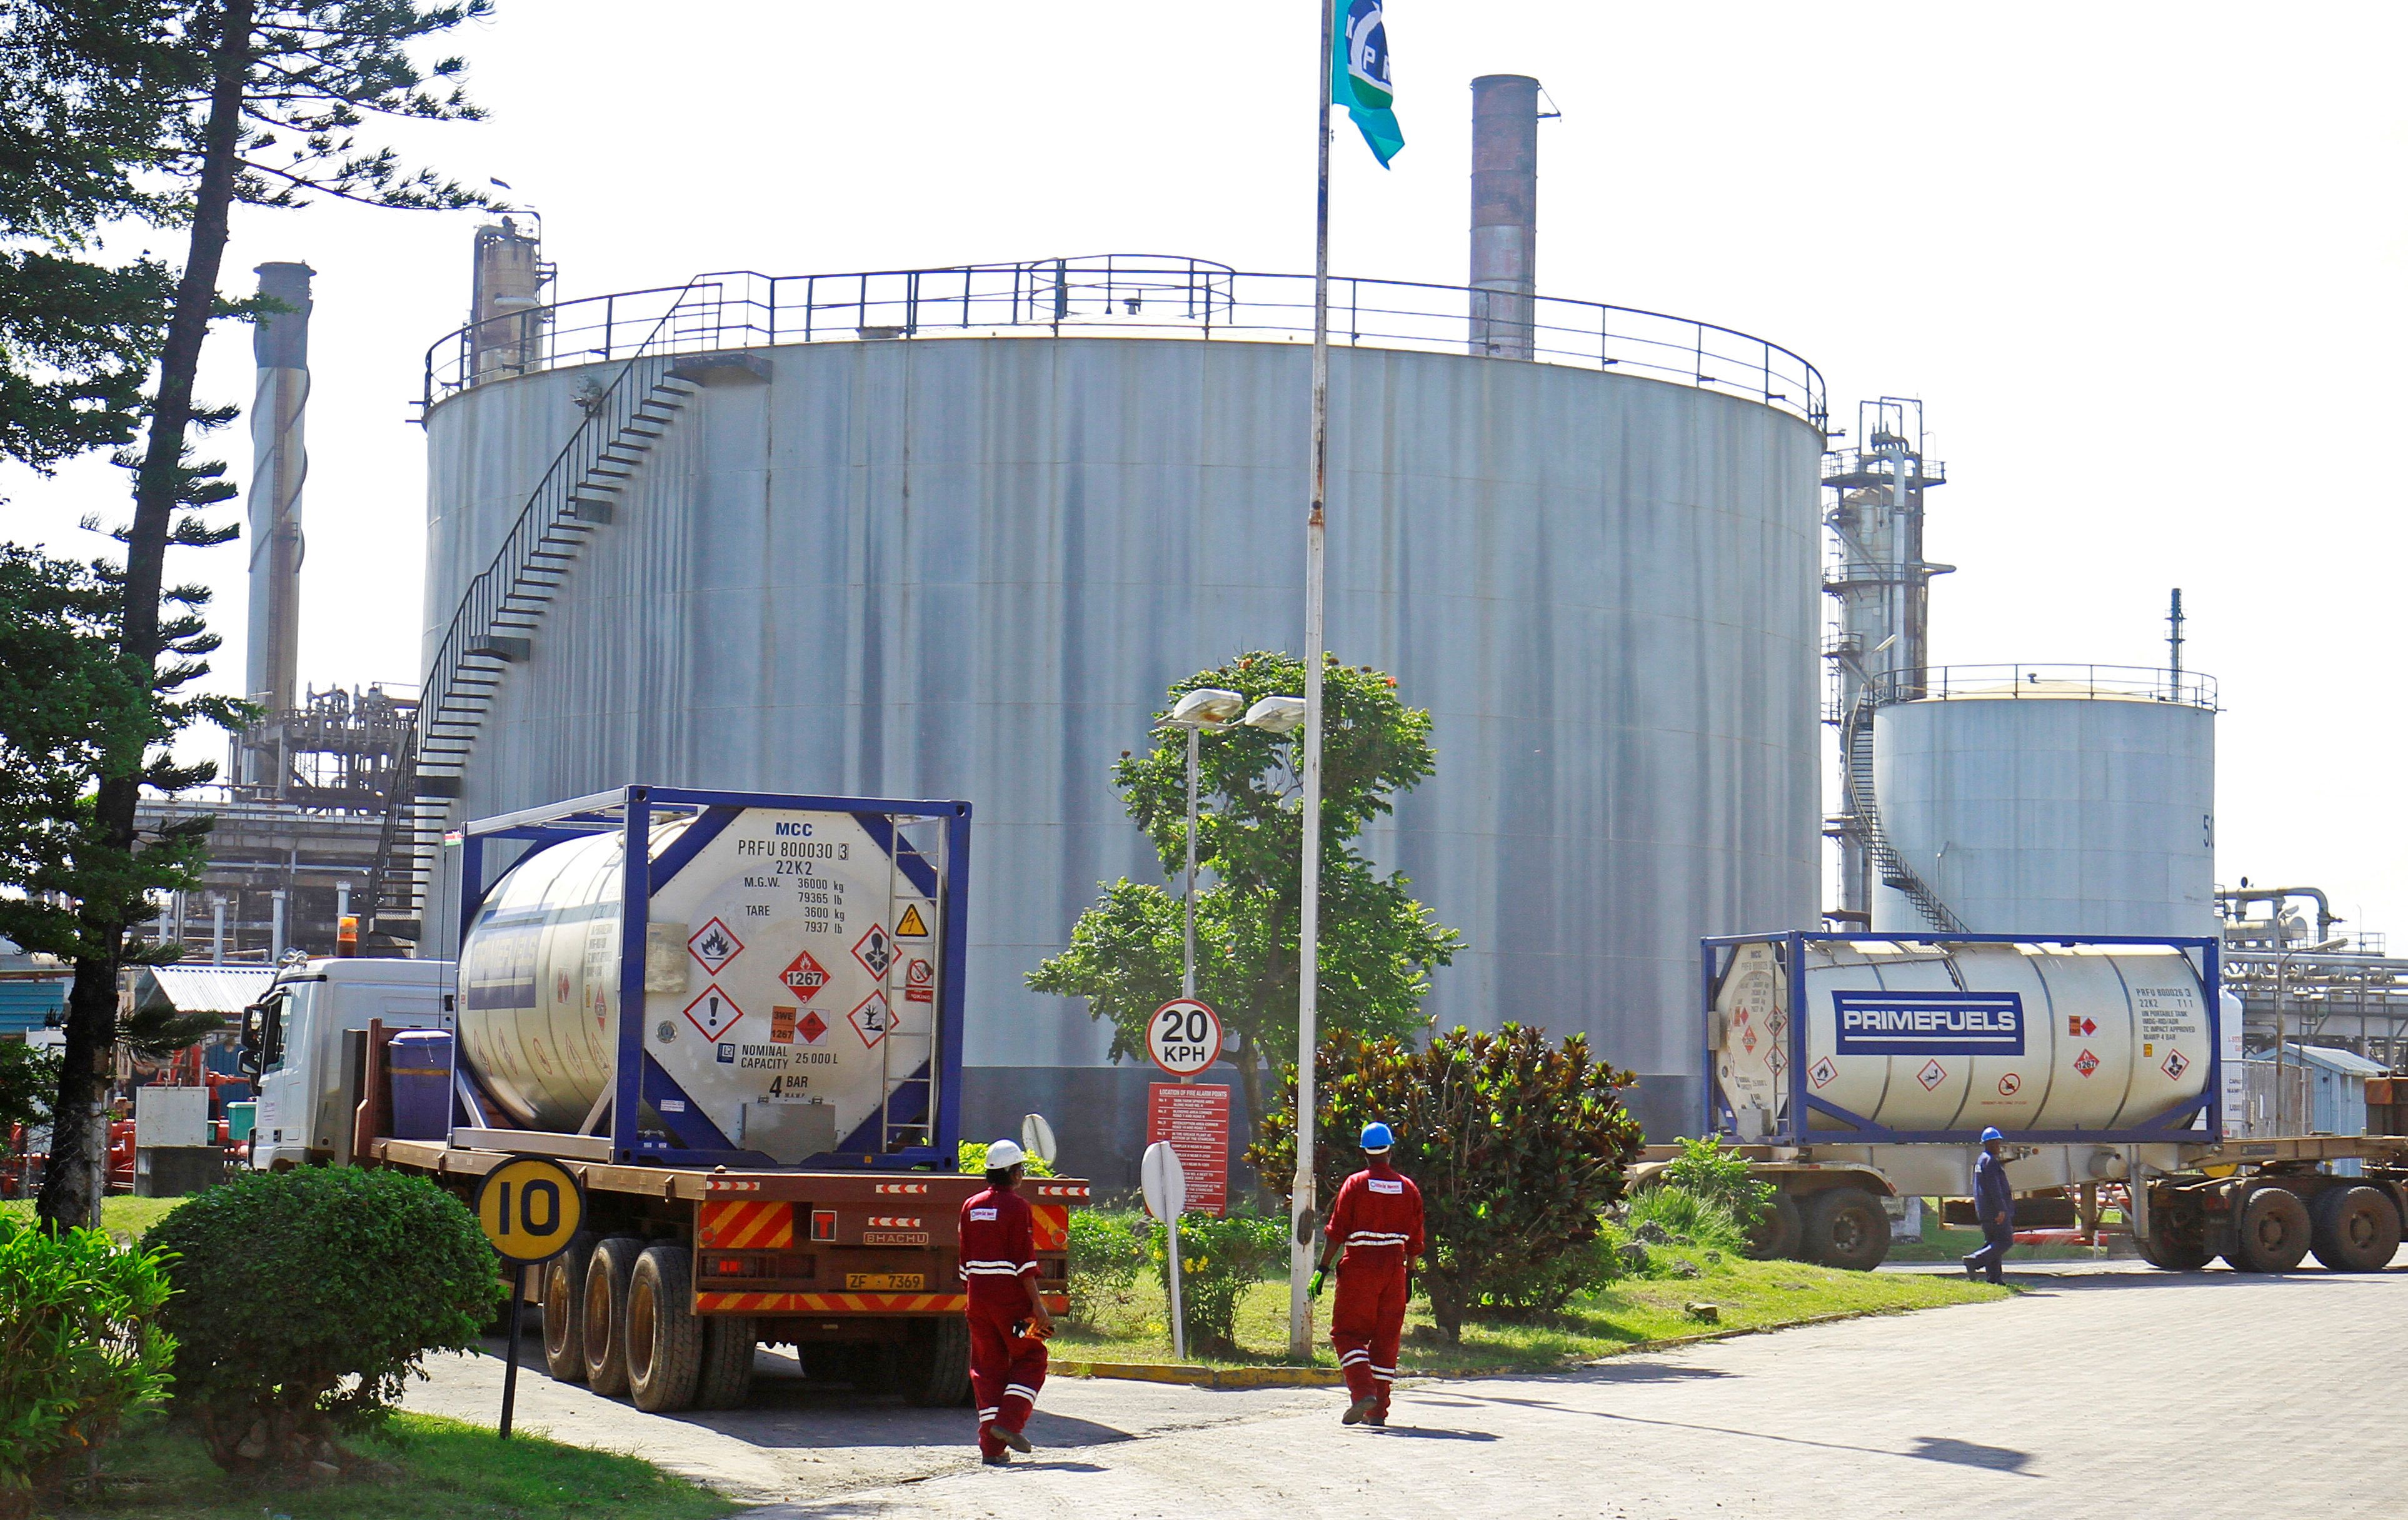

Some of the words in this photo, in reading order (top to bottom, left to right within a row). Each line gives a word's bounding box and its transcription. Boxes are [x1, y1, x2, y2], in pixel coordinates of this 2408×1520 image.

[776, 822, 812, 836] MCC
[738, 840, 775, 856] PRFU
[781, 842, 832, 858] 800030
[840, 844, 847, 860] 3
[776, 860, 812, 875] 22K2
[744, 877, 780, 887] M.G.W.
[798, 878, 827, 890] 36000
[833, 881, 844, 893] kg
[798, 892, 828, 903] 79365
[834, 895, 842, 905] lb
[746, 905, 770, 916] TARE
[805, 907, 828, 918] 3600
[835, 909, 845, 922] kg
[805, 922, 828, 933] 7937
[835, 924, 842, 934] lb
[788, 972, 822, 985] 1267
[2136, 989, 2155, 997] PRFU
[2139, 999, 2158, 1007] 22K2
[1161, 1010, 1208, 1043] 20
[1844, 1010, 2016, 1030] PRIMEFUELS
[771, 1030, 793, 1039] 1267
[742, 1045, 788, 1057] NOMINAL
[1164, 1046, 1205, 1062] KPH
[741, 1057, 788, 1069] CAPACITY
[833, 1054, 838, 1064] L
[2078, 1060, 2095, 1069] 1267
[770, 1075, 782, 1098] 4
[786, 1075, 808, 1087] BAR
[499, 1179, 560, 1236] 10
[815, 1214, 833, 1238] T
[867, 1234, 925, 1243] BHACHU
[850, 1276, 867, 1288] ZF
[888, 1276, 920, 1288] 7369
